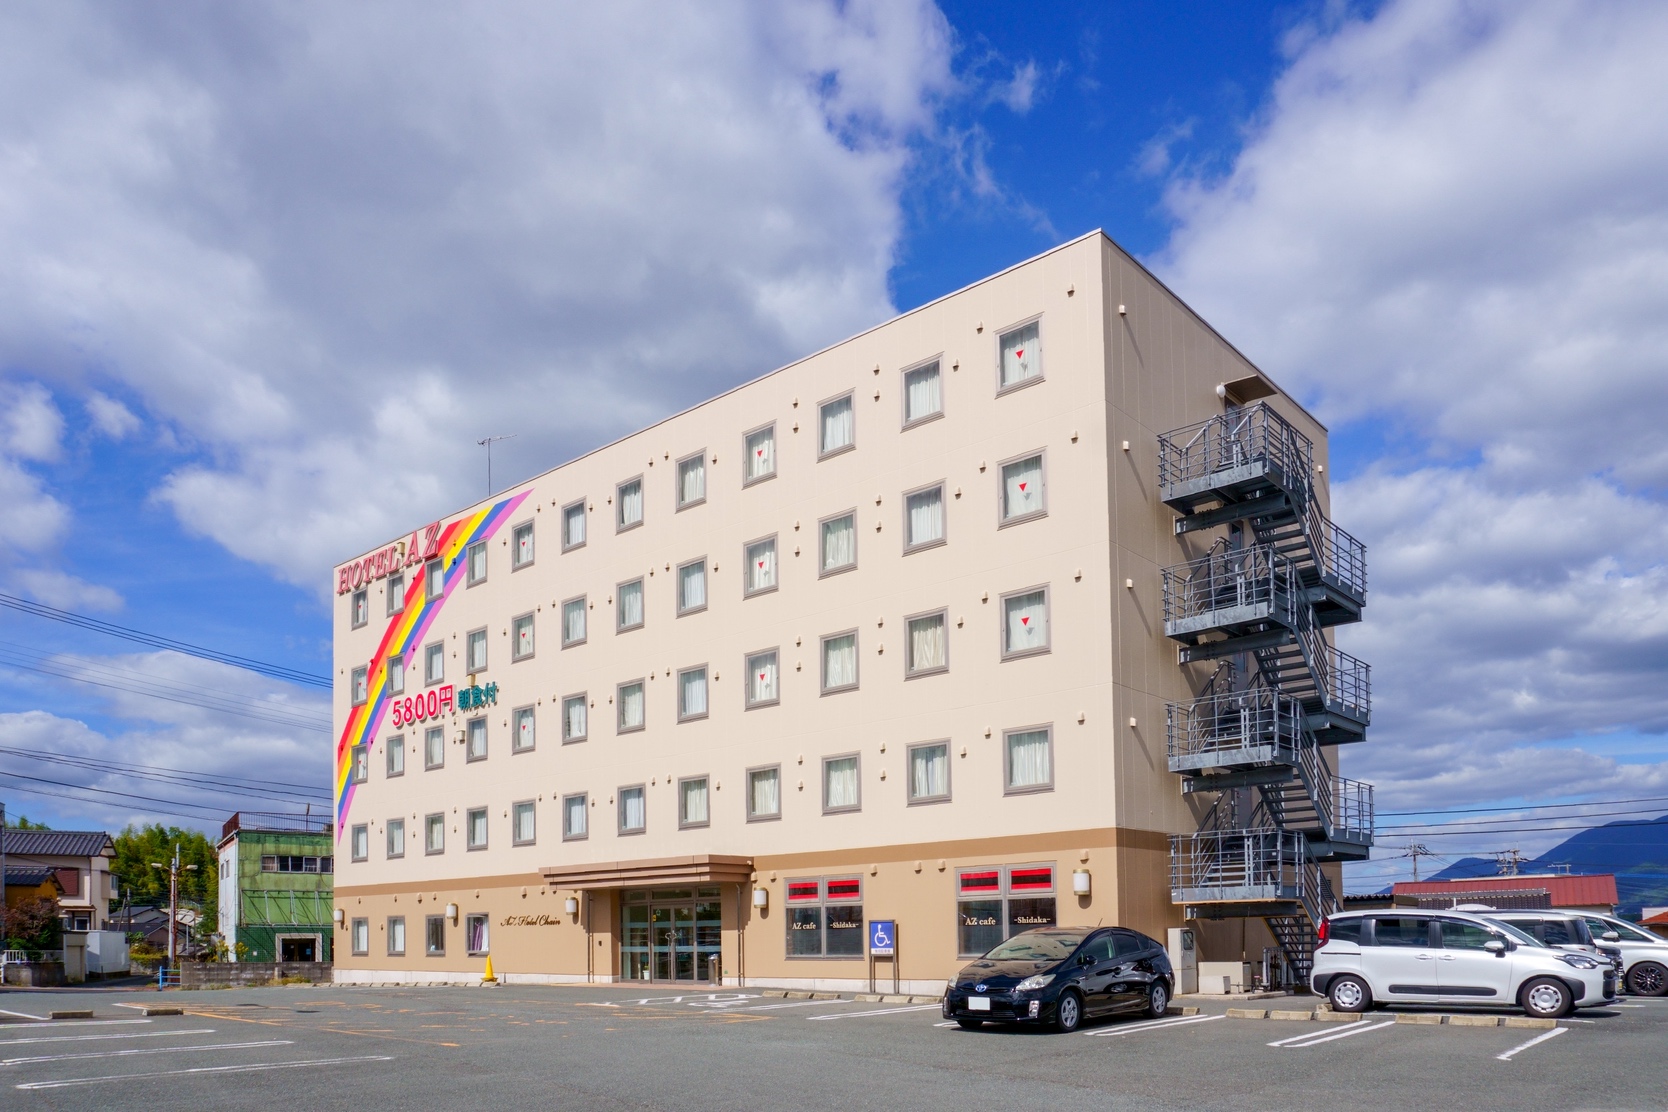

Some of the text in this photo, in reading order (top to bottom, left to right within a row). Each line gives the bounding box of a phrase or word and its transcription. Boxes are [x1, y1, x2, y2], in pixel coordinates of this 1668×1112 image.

[336, 521, 440, 595] HOTEL AZ
[392, 684, 455, 727] 5800円
[518, 915, 540, 927] Hotel
[539, 915, 561, 927] Chain
[965, 917, 996, 926] AZ cafe
